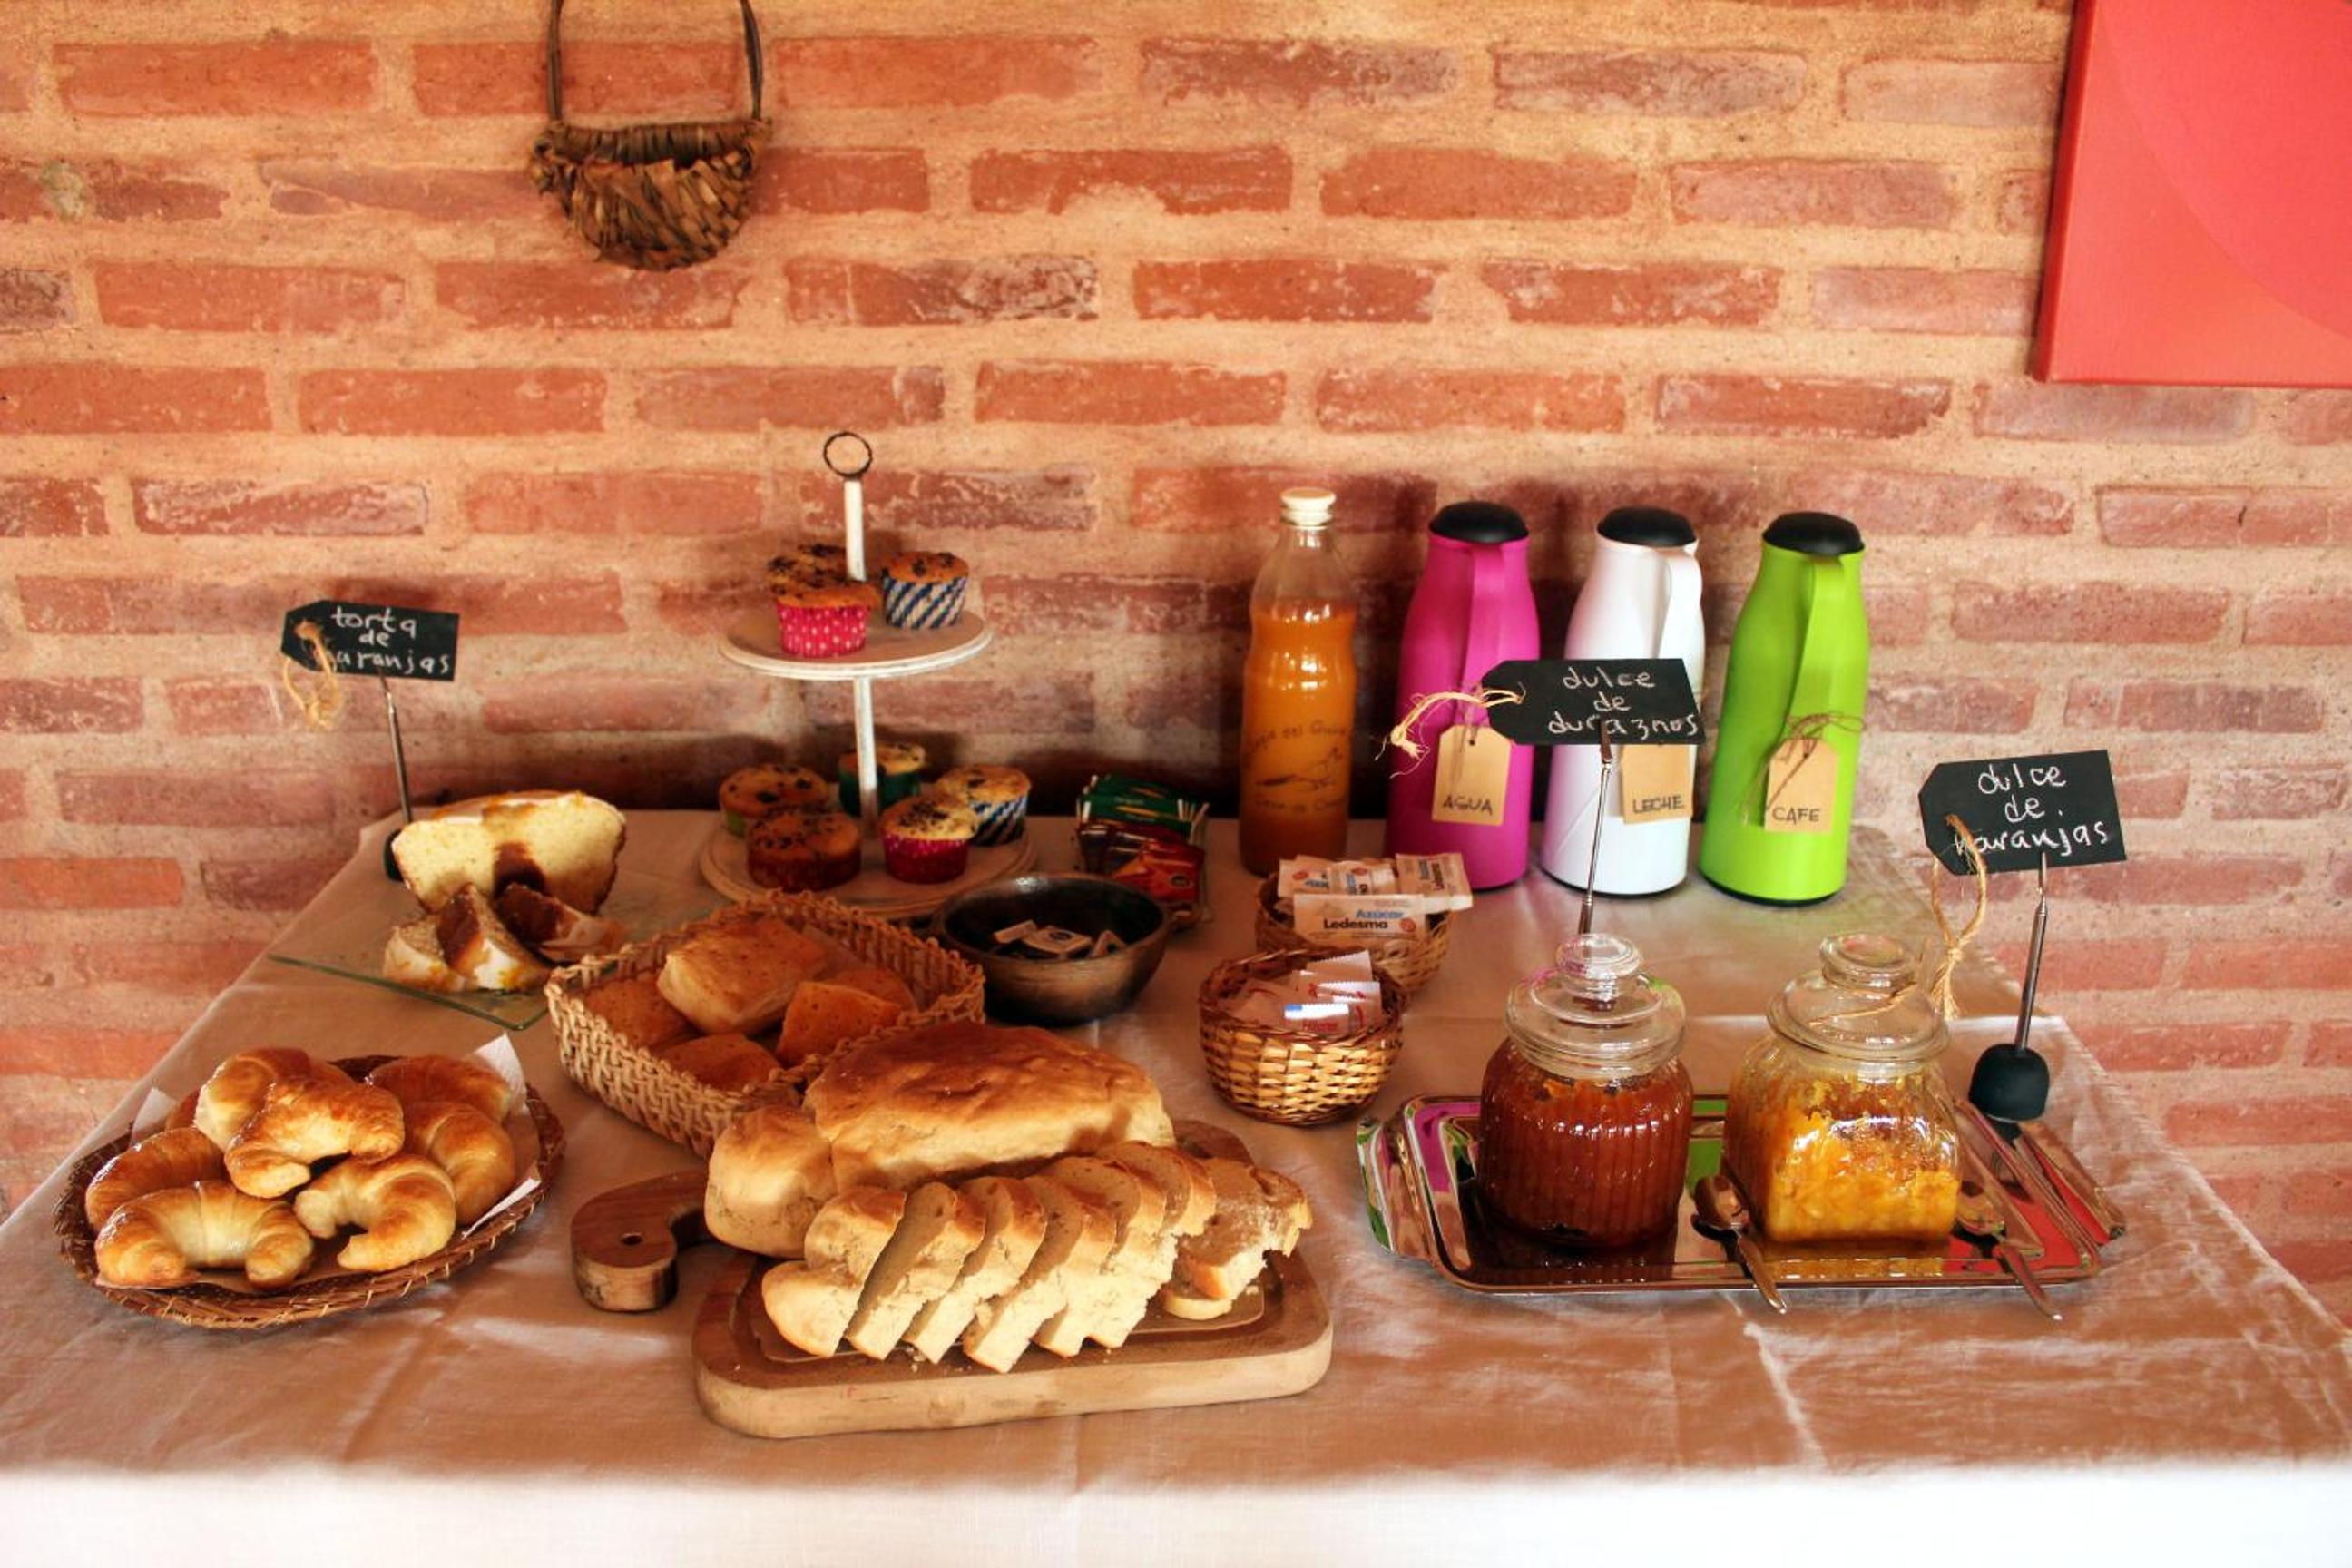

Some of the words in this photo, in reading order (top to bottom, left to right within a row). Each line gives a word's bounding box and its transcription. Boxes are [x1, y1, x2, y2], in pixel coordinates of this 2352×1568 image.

[330, 606, 416, 638] torta
[358, 629, 390, 647] de
[328, 650, 450, 675] aranjas
[1562, 665, 1656, 690] dulce
[1593, 691, 1632, 711] de
[1977, 762, 2067, 795] dulce
[1442, 794, 1494, 817] AGUA
[1632, 794, 1685, 814] LECHE
[1771, 805, 1821, 825] CAFE
[2004, 793, 2046, 823] de
[1323, 916, 1389, 929] Ledesma
